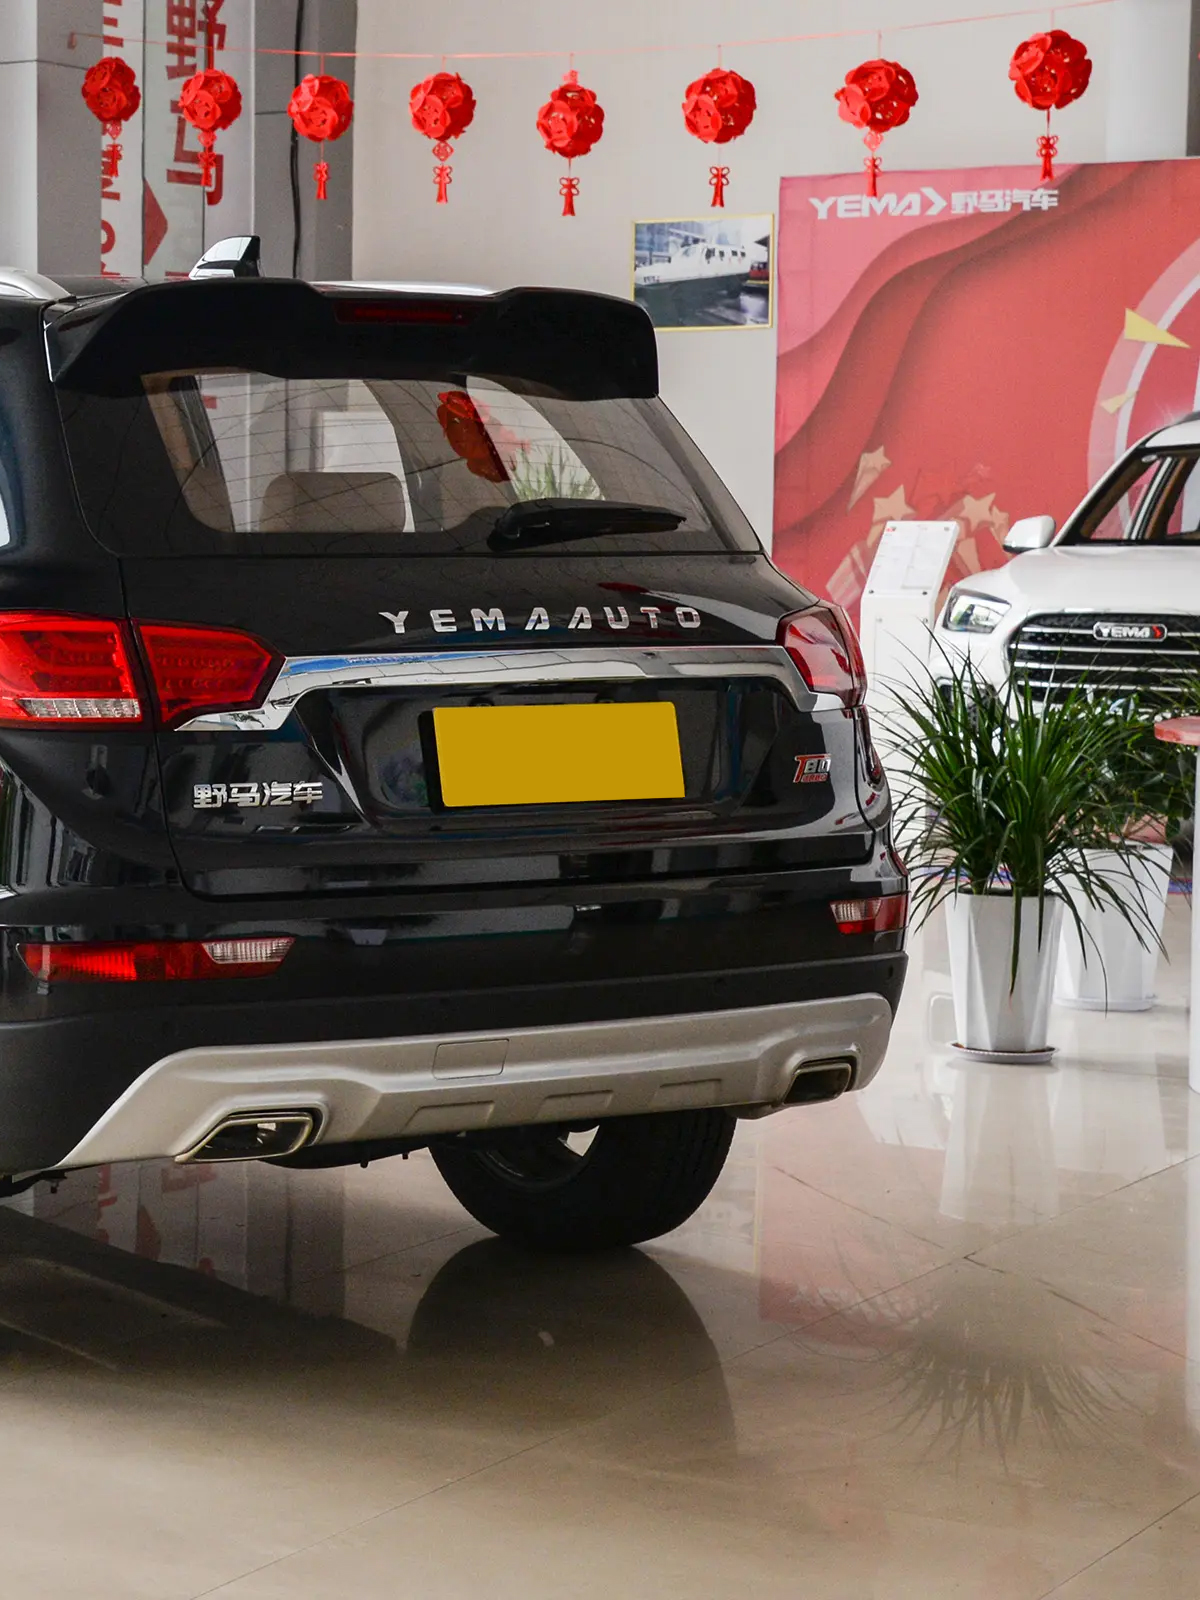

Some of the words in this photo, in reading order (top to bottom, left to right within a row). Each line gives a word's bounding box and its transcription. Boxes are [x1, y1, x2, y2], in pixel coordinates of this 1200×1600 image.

[809, 192, 922, 220] YEMA
[951, 188, 1059, 214] 野马汽车
[1099, 626, 1151, 638] YEMA
[193, 781, 323, 809] 野马汽车
